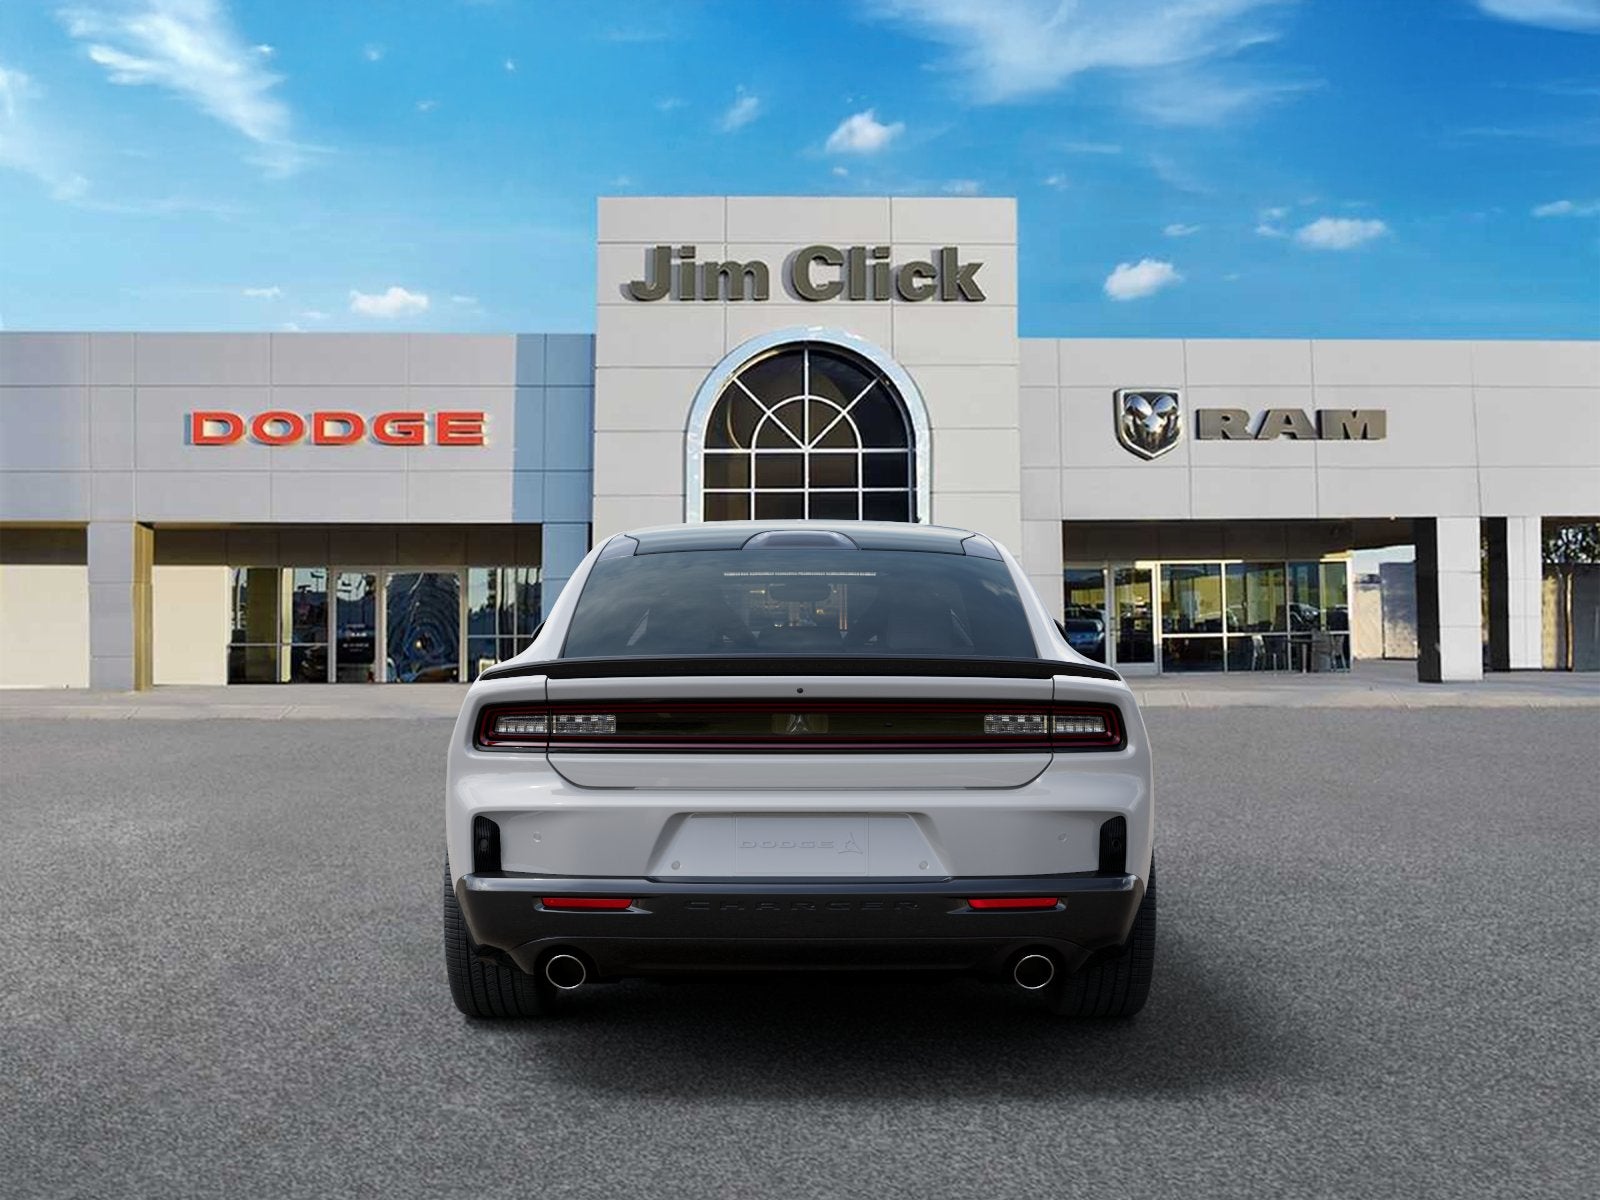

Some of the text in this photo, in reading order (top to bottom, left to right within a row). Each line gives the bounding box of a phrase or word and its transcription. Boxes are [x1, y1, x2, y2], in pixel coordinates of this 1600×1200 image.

[628, 245, 986, 301] Jim Click
[190, 410, 487, 446] DODGE
[1196, 408, 1387, 440] RAM
[739, 840, 835, 849] DODGE
